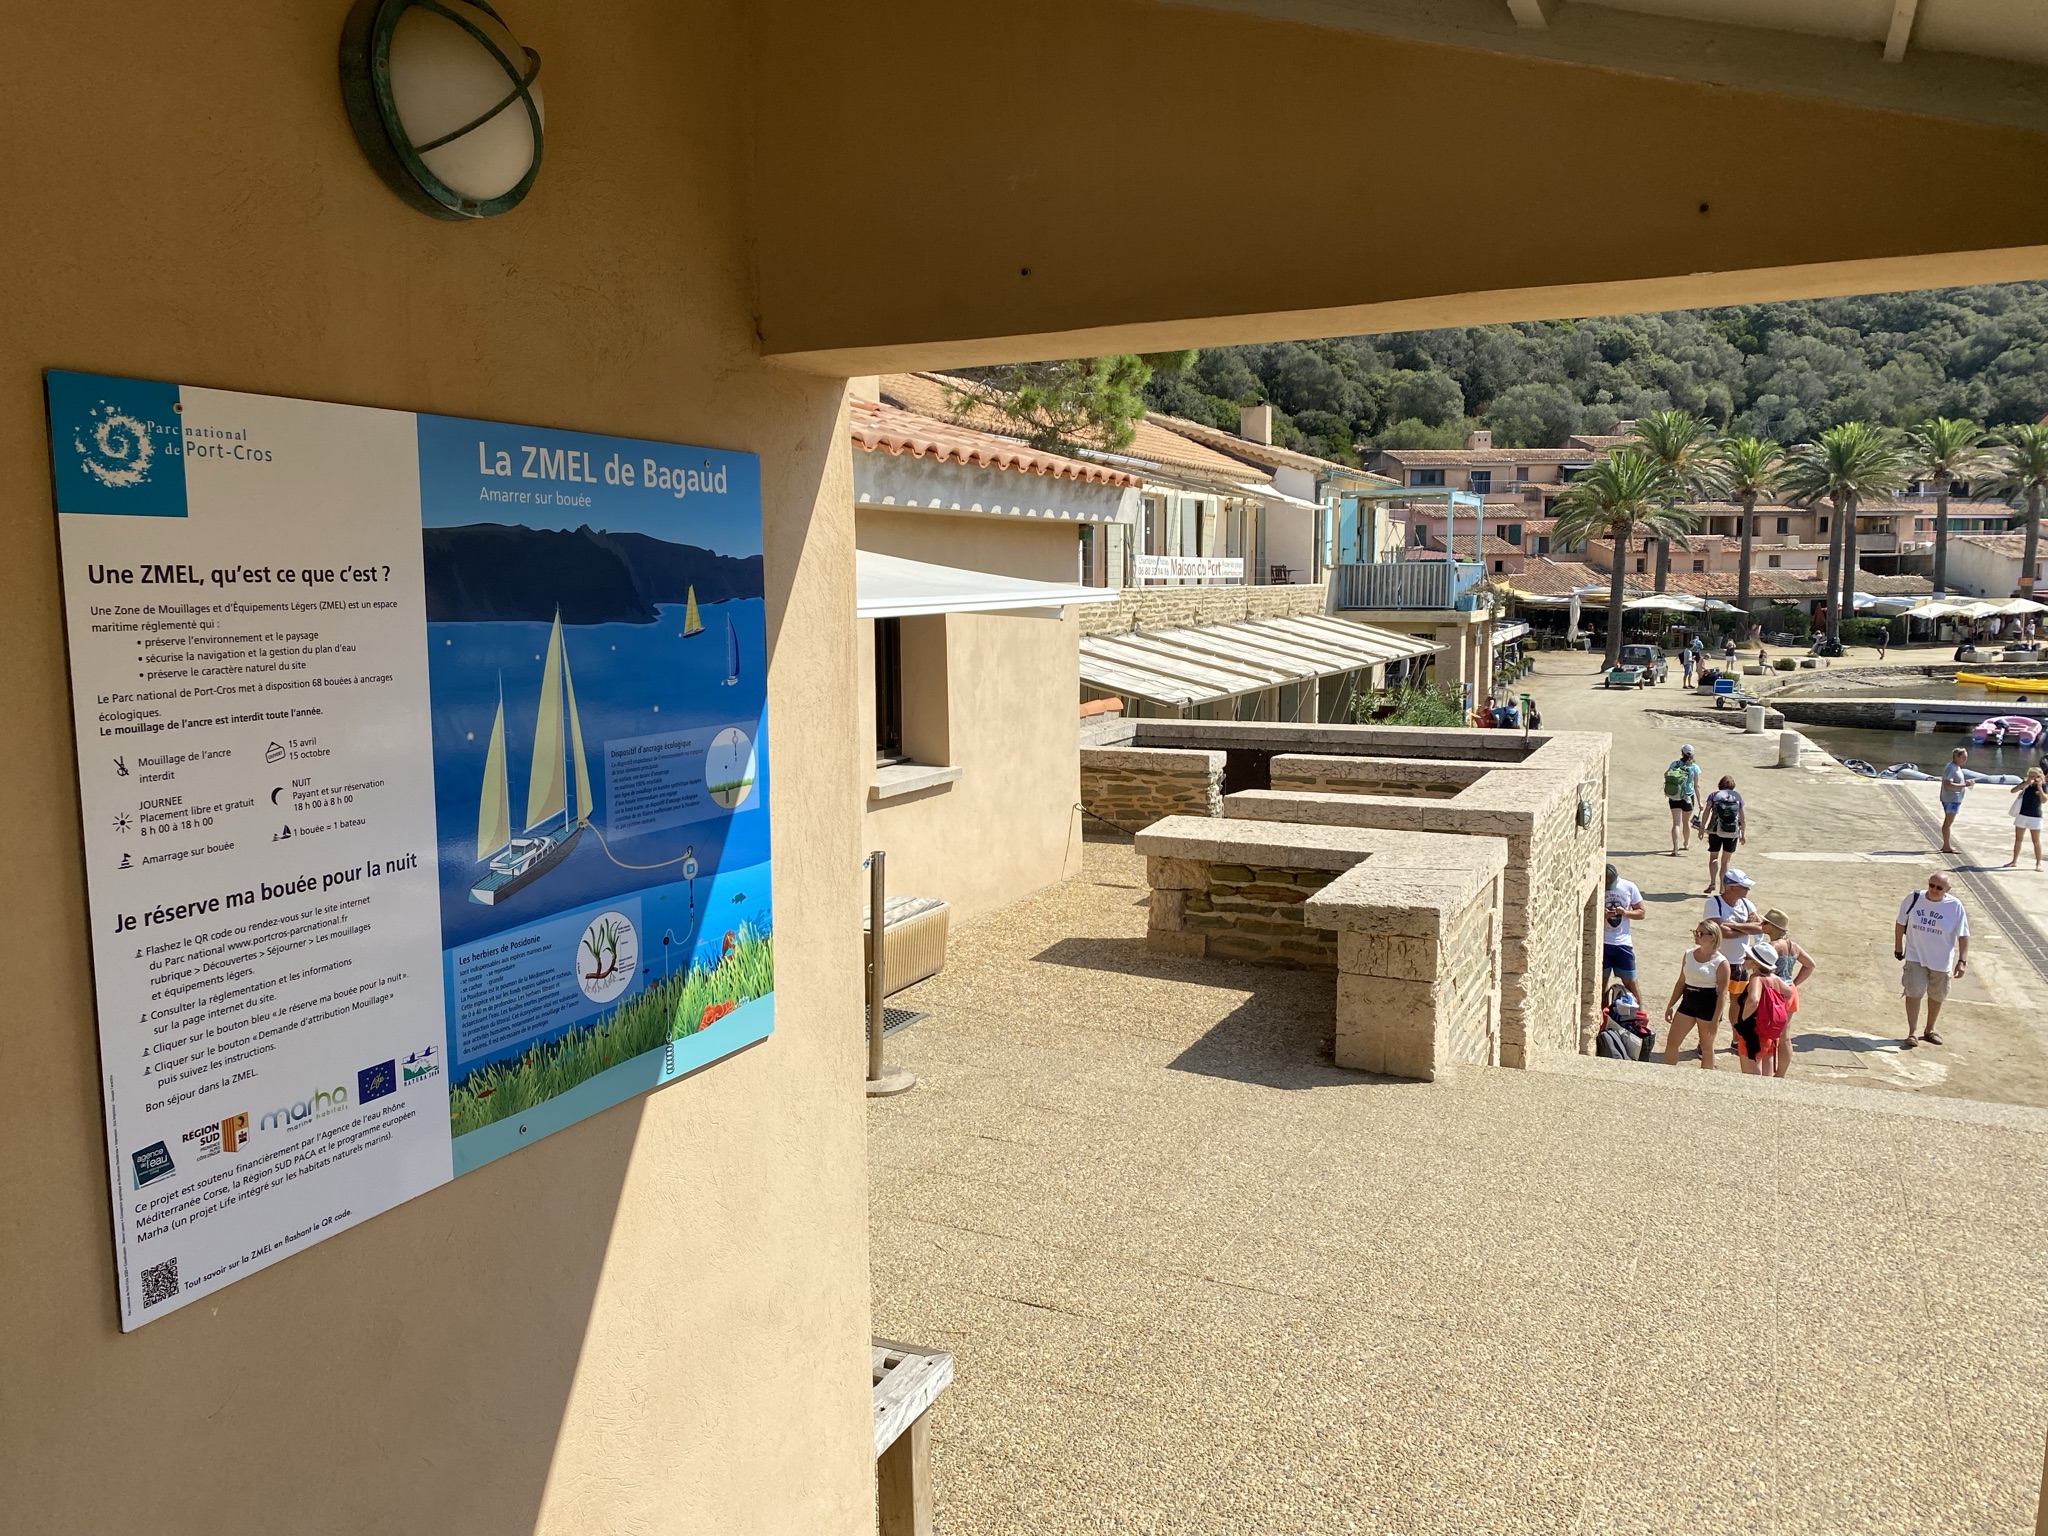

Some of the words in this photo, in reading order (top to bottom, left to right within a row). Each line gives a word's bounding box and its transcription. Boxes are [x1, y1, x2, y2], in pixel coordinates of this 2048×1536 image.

[147, 420, 179, 436] Parc
[185, 426, 247, 441] national
[165, 442, 180, 456] de
[187, 441, 272, 462] Port-Cros
[479, 442, 511, 476] La
[521, 446, 597, 483] ZMEL
[604, 454, 634, 486] de
[644, 458, 726, 498] Bagaud
[480, 486, 531, 503] Amarrer
[535, 492, 552, 504] sur
[556, 491, 591, 507] bouée
[88, 564, 133, 584] Une
[140, 564, 204, 586] ZMEL,
[210, 565, 271, 588] qu'est
[276, 569, 295, 582] ce
[301, 569, 334, 587] que
[339, 565, 377, 582] c'est
[1171, 559, 1195, 576] Maison
[90, 606, 112, 615] Une
[114, 605, 140, 615] Zone
[142, 604, 155, 614] de
[158, 603, 210, 615] Mouillages
[212, 604, 222, 612] et
[224, 601, 289, 614] d'Équipements
[290, 601, 317, 612] Légers
[318, 600, 346, 611] (ZMEL)
[372, 601, 397, 609] espace
[91, 621, 138, 632] maritime
[141, 619, 197, 633] réglementé
[199, 619, 214, 631] qui
[144, 636, 186, 649] préserve
[188, 633, 263, 644] l'environnement
[264, 633, 273, 641] et
[275, 631, 283, 641] le
[285, 632, 318, 642] paysage
[146, 668, 188, 681] préserve
[190, 666, 199, 676] le
[201, 664, 243, 676] caractère
[245, 661, 276, 672] naturel
[278, 660, 289, 670] du
[291, 660, 306, 670] site
[99, 726, 112, 736] Le
[114, 722, 164, 734] mouillage
[166, 719, 179, 729] de
[181, 718, 212, 728] l'ancre
[214, 715, 229, 725] est
[230, 711, 264, 723] interdit
[265, 710, 289, 719] toute
[288, 739, 297, 748] 15
[299, 736, 316, 747] avril
[138, 754, 185, 767] Mouillage
[187, 751, 199, 761] de
[201, 749, 231, 759] l'ancre
[289, 750, 298, 760] 15
[300, 748, 330, 758] octobre
[139, 770, 175, 783] interdit
[292, 777, 311, 788] NUIT
[292, 788, 319, 800] Payant
[320, 787, 329, 795] et
[330, 786, 342, 794] sur
[344, 780, 384, 792] réservation
[138, 795, 182, 810] JOURNEE
[139, 808, 188, 823] Placement
[190, 805, 211, 815] libre
[213, 803, 222, 812] et
[224, 798, 254, 812] gratuit
[141, 850, 188, 865] Amarrage
[190, 847, 204, 856] sur
[206, 841, 234, 853] bouée
[114, 913, 136, 933] Je
[144, 898, 219, 926] réserve
[226, 890, 254, 908] ma
[260, 874, 317, 901] bouée
[322, 867, 362, 892] pour
[366, 860, 380, 877] la
[386, 852, 417, 873] nuit
[314, 907, 322, 915] le
[324, 904, 338, 914] site
[339, 896, 370, 909] internet
[248, 913, 299, 931] rendez-vous
[300, 910, 313, 919] sur
[194, 933, 208, 944] QR
[210, 928, 353, 940] code
[234, 926, 246, 934] ou
[145, 941, 181, 956] Flashez
[183, 937, 192, 947] le
[459, 957, 470, 965] Les
[472, 947, 499, 961] herbiers
[501, 944, 508, 952] de
[511, 935, 540, 950] Posidonie
[157, 1073, 177, 1089] puis
[179, 1064, 208, 1080] suivez
[210, 1059, 222, 1070] les
[404, 1074, 427, 1087] NATURA
[145, 1100, 164, 1112] Bon
[166, 1089, 196, 1105] séjour
[198, 1081, 219, 1094] dans
[221, 1077, 230, 1086] la
[261, 1086, 348, 1131] marha
[182, 1122, 219, 1142] RÉGION
[287, 1118, 313, 1132] marine
[200, 1132, 220, 1146] SUD
[134, 1203, 147, 1213] Ce
[150, 1189, 179, 1210] projet
[181, 1183, 195, 1195] est
[196, 1169, 233, 1189] soutenu
[235, 1142, 299, 1173] financièrement
[301, 1136, 314, 1150] par
[316, 1123, 350, 1141] l'Agence
[351, 1118, 361, 1127] de
[362, 1111, 380, 1123] l'eau
[382, 1101, 405, 1115] Rhône
[183, 1276, 201, 1290] Tout
[203, 1265, 226, 1281] savoir
[228, 1260, 240, 1270] sur
[241, 1255, 249, 1263] la
[250, 1243, 272, 1259] ZMEL
[273, 1240, 283, 1248] en
[284, 1226, 311, 1244] flashant
[313, 1222, 319, 1231] le
[321, 1216, 332, 1226] QR
